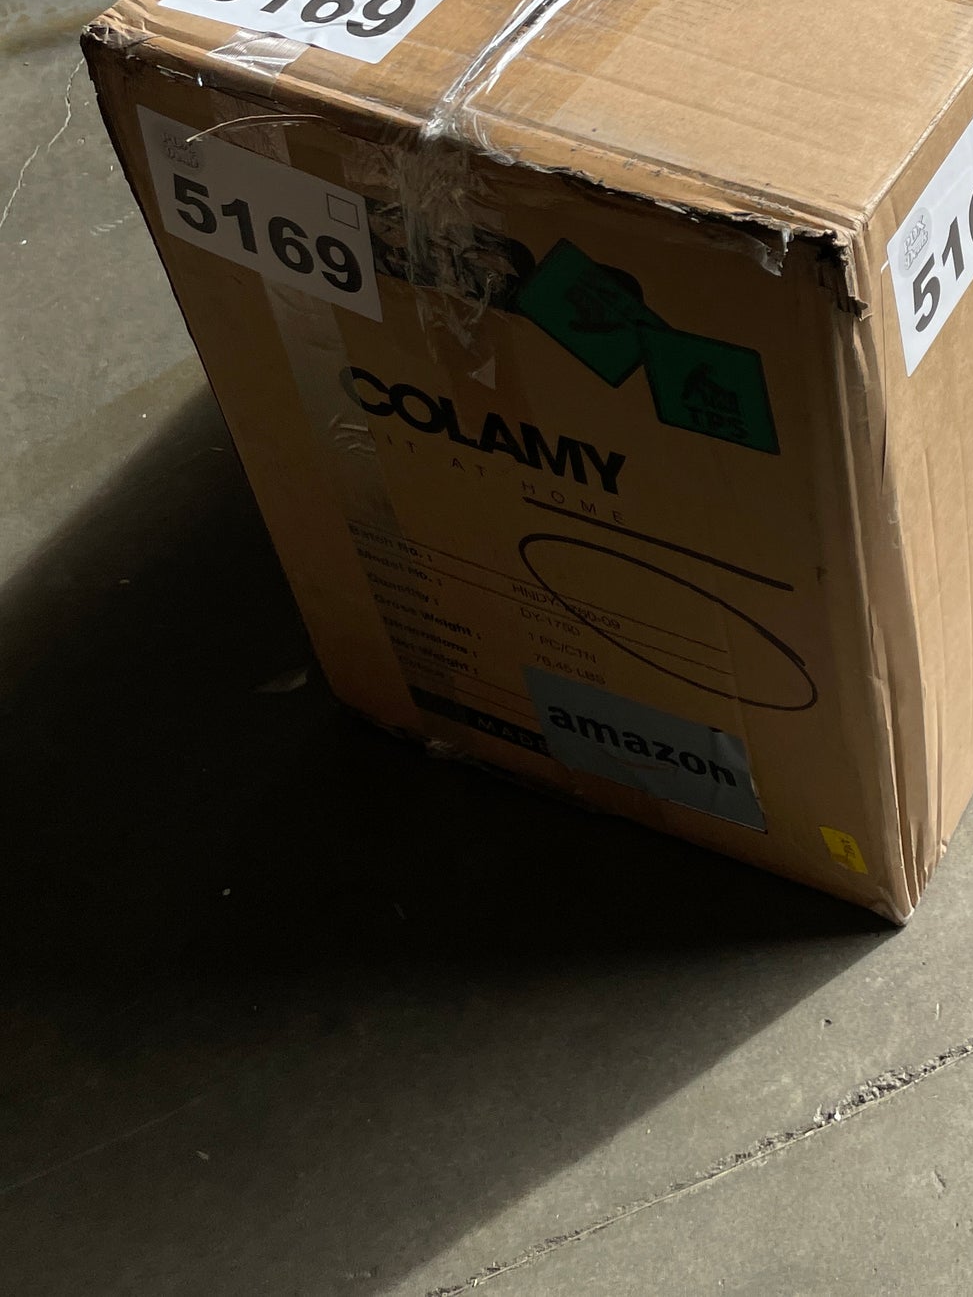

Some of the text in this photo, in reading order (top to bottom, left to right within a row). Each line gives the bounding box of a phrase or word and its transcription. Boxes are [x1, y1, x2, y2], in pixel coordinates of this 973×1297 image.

[173, 173, 363, 293] 5169
[903, 214, 927, 251] PDX
[339, 366, 626, 495] COLAMY
[522, 480, 624, 524] HOME
[548, 705, 737, 787] amazon
